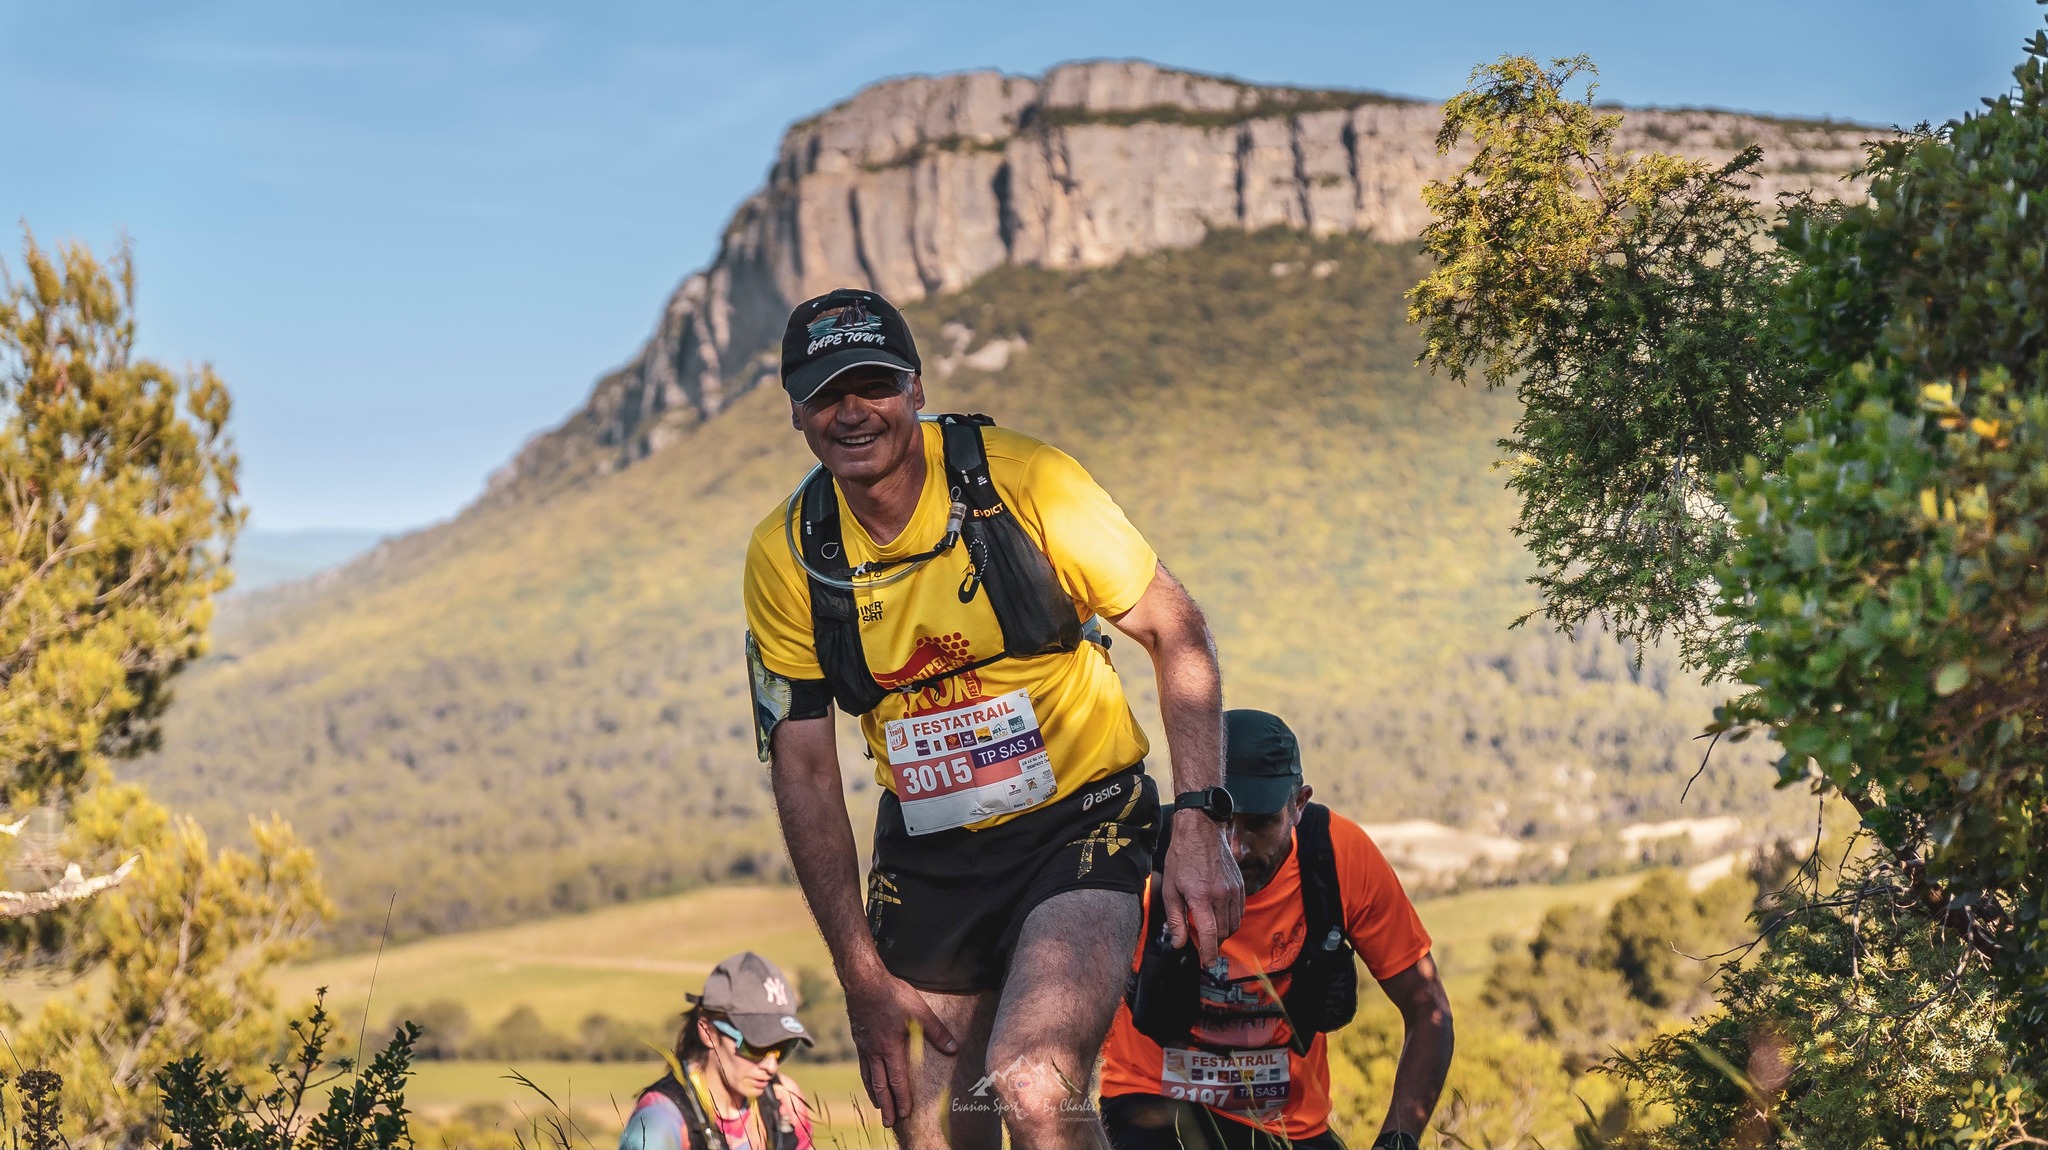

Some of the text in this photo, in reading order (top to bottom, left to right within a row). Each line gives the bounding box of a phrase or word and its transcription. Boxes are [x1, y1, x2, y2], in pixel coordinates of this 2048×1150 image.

[807, 332, 886, 355] CAPE TOWN
[973, 502, 1004, 518] EDICT
[912, 701, 1016, 737] FESTATRAIL
[978, 750, 996, 765] TP
[1000, 739, 1028, 759] SAS
[1029, 735, 1038, 748] 1
[902, 756, 973, 795] 3015
[1095, 783, 1121, 803] asics
[1192, 1053, 1278, 1068] FESTATRAIL
[1255, 1087, 1277, 1097] SAS
[1280, 1086, 1285, 1095] 1
